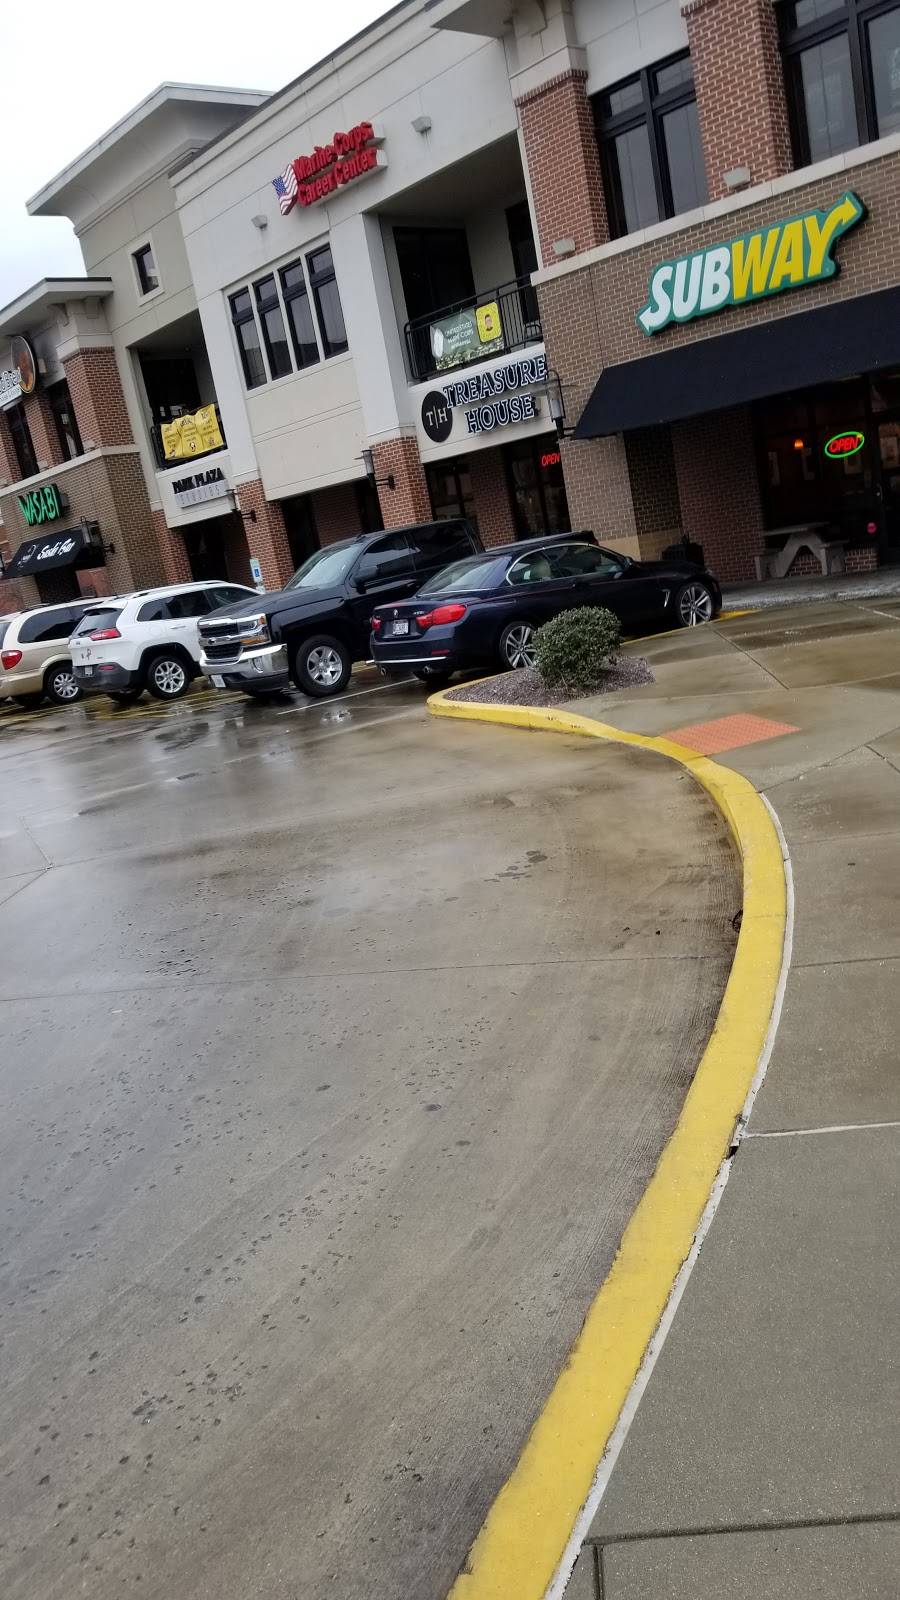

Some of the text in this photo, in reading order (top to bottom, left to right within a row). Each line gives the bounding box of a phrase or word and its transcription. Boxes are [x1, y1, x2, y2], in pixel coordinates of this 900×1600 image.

[293, 122, 375, 181] Marine Corps
[297, 147, 378, 208] Career Center
[639, 197, 858, 331] SUBWAY
[442, 353, 548, 409] TREASURE
[464, 392, 536, 433] HOUSE
[541, 452, 561, 467] OPEN
[828, 436, 859, 453] OPEN
[171, 467, 225, 495] PARK PLAZA
[18, 484, 61, 527] WASABI
